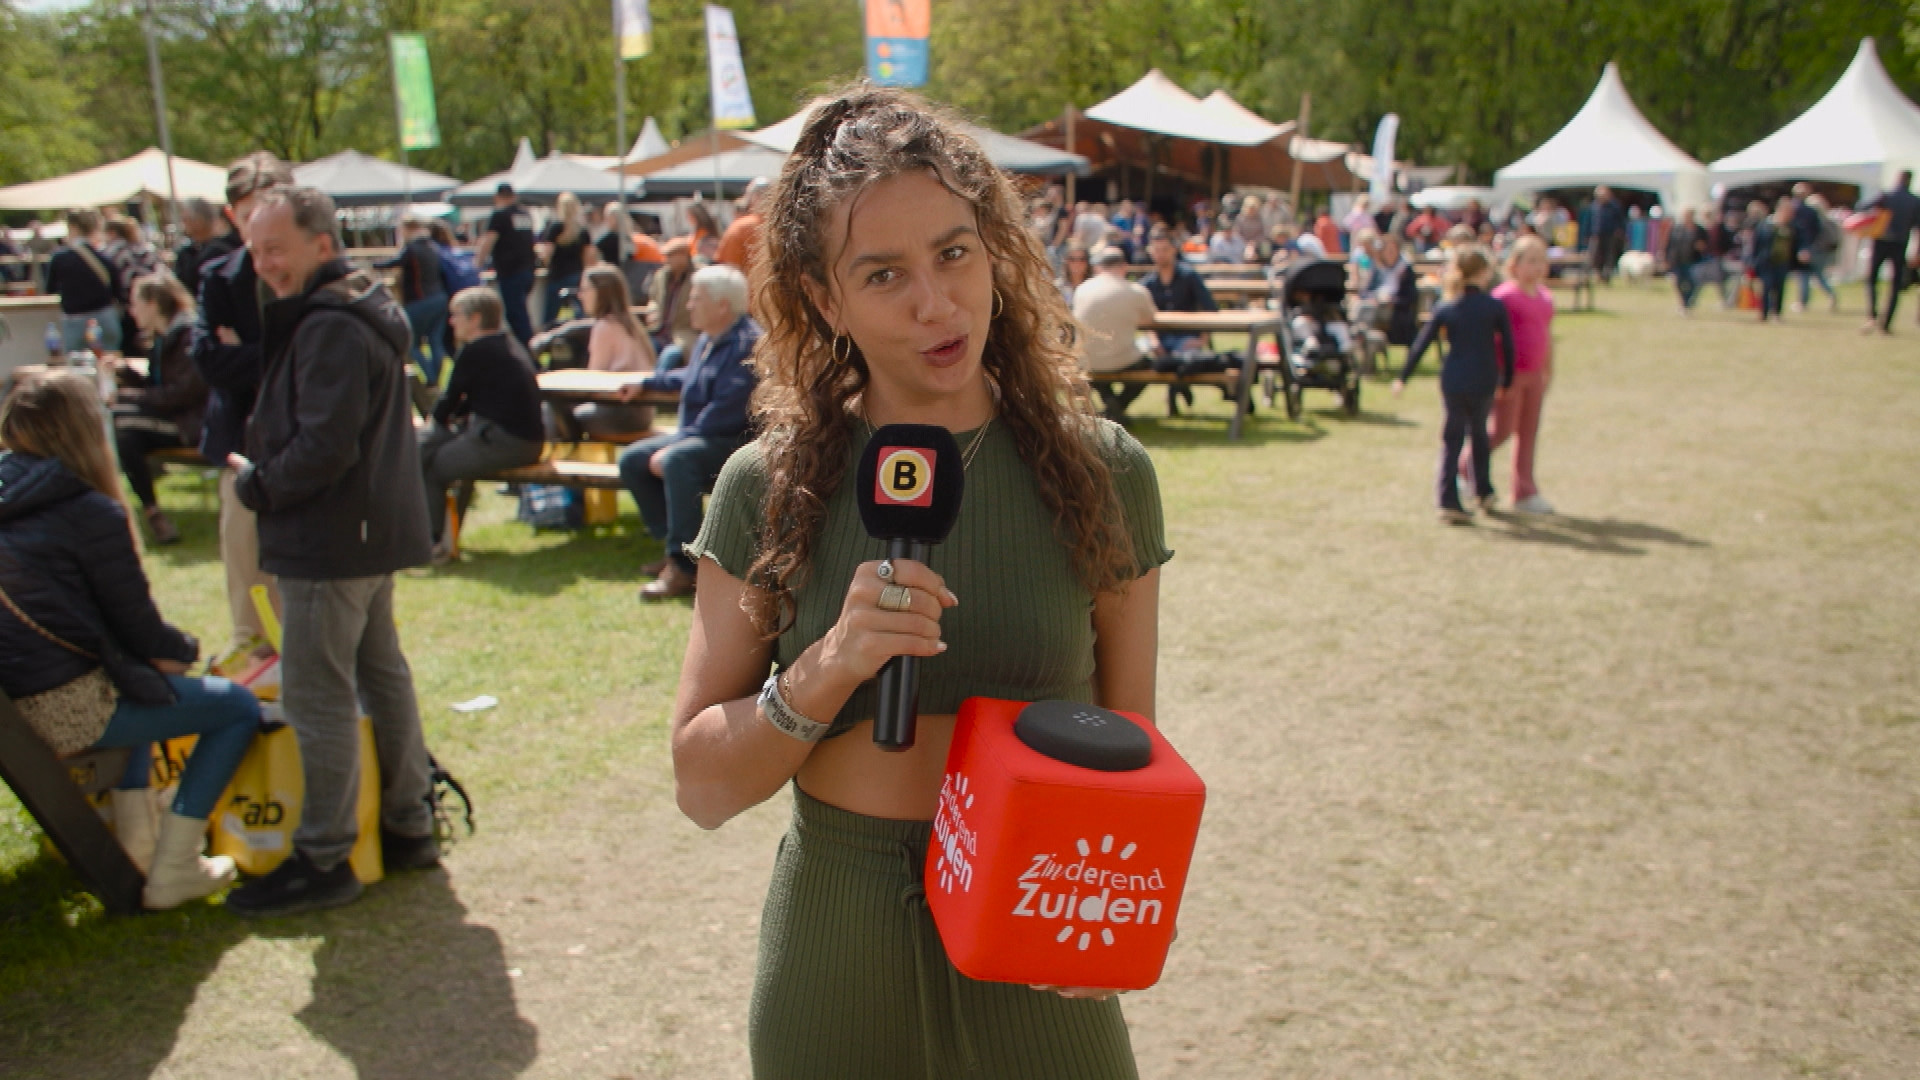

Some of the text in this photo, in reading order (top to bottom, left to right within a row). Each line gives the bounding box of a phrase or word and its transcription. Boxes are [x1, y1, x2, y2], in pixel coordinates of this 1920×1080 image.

[893, 460, 917, 491] B
[934, 795, 972, 893] Zuiden
[1017, 853, 1166, 890] Zinderend
[1011, 882, 1162, 924] Zuiden
